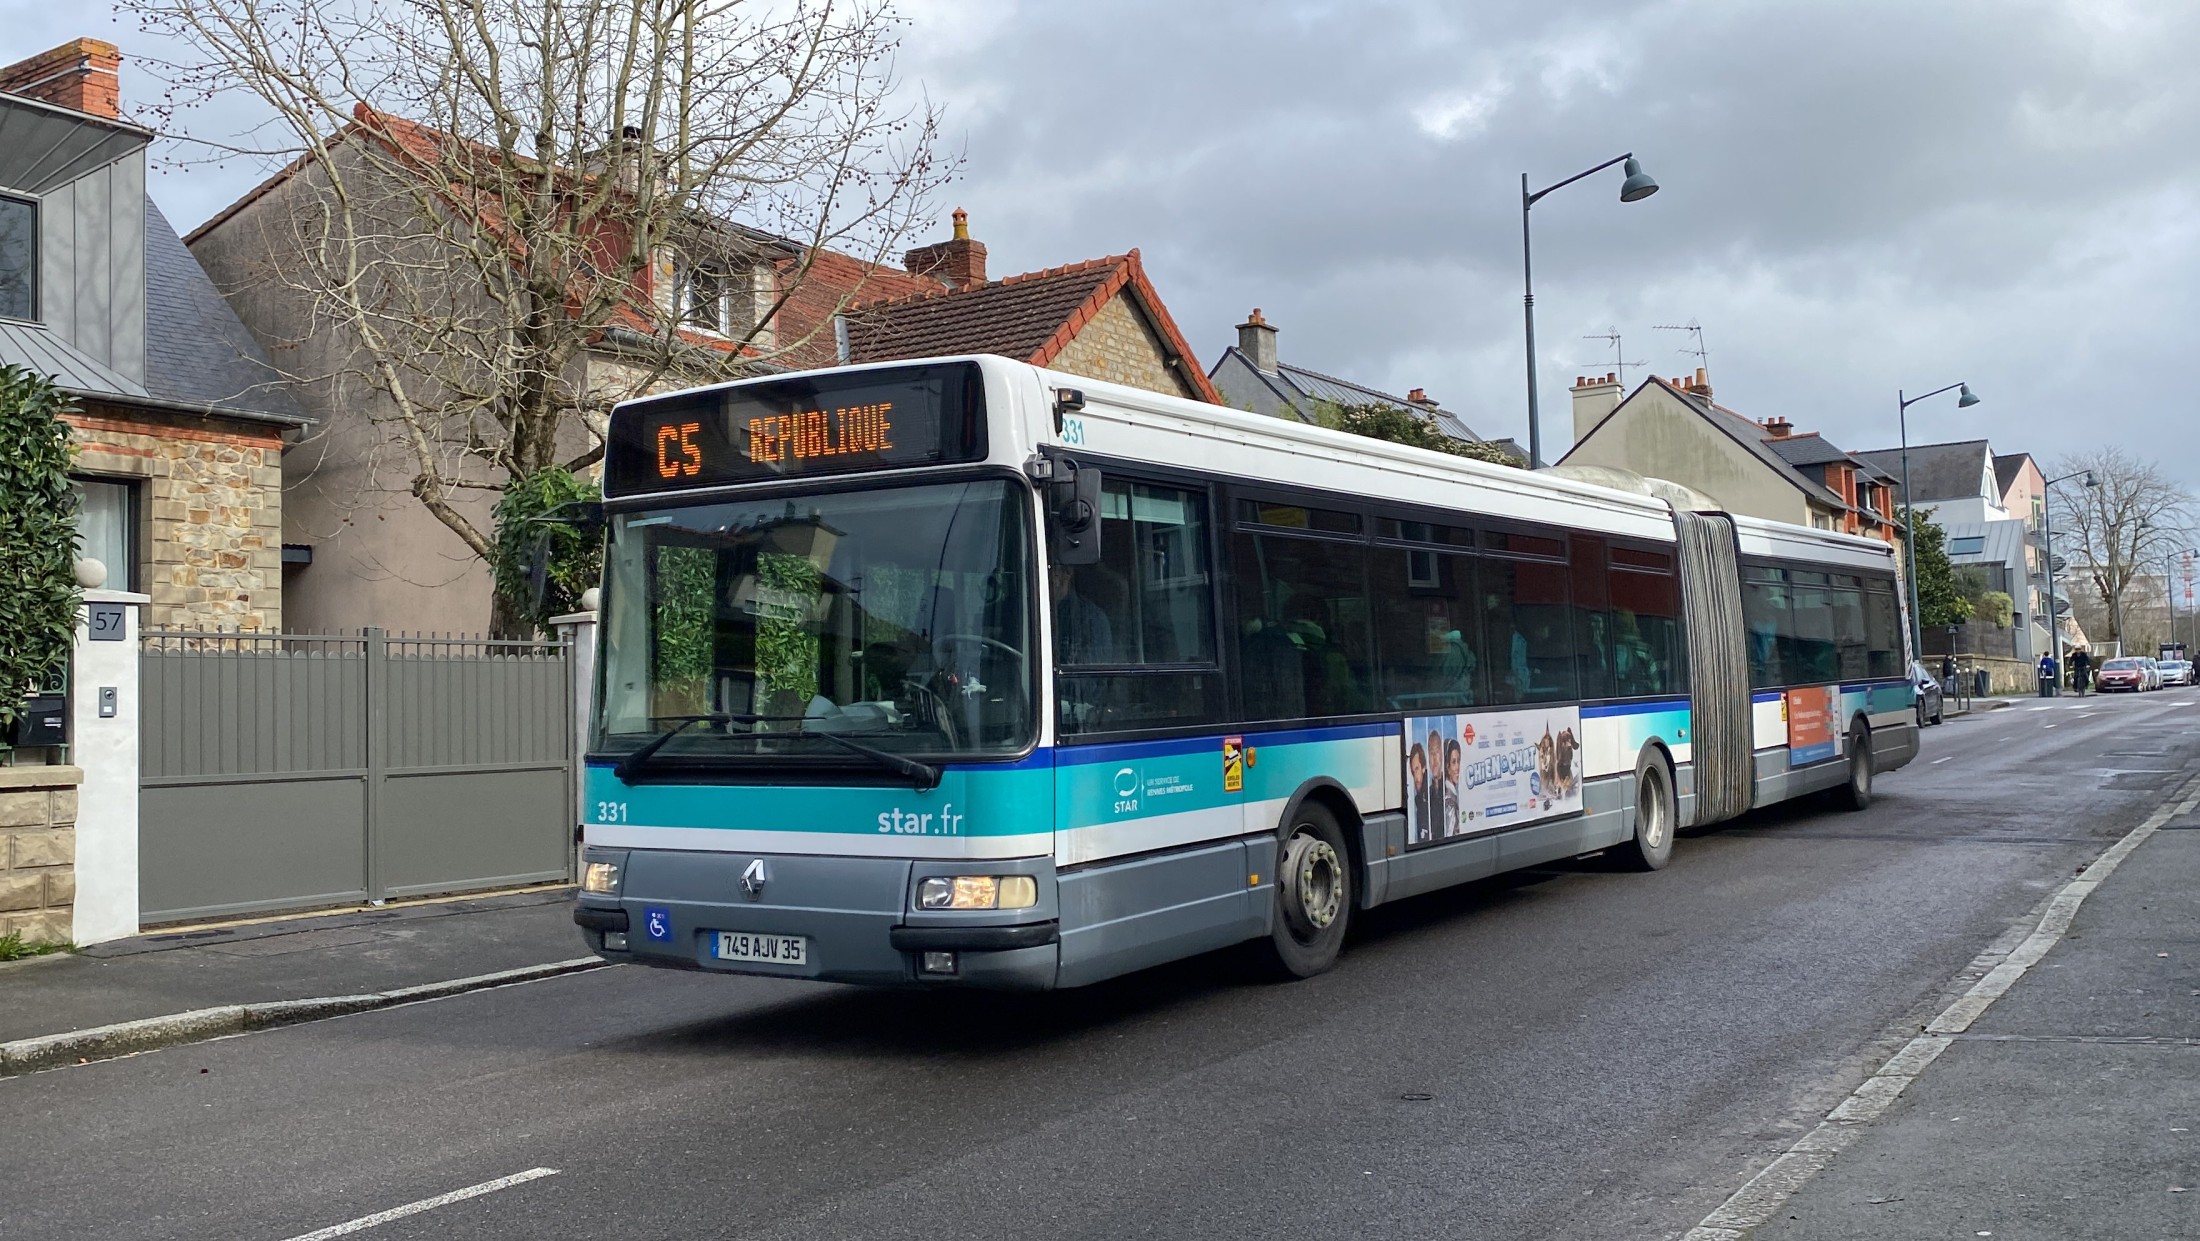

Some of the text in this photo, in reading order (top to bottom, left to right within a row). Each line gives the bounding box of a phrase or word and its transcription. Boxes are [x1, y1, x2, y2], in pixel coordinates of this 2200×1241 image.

[657, 402, 893, 478] C5 REPUBLIQUE
[1062, 418, 1084, 445] 331
[95, 612, 122, 631] 57
[1508, 745, 1537, 775] CHAT
[1147, 784, 1194, 797] RENNES MÉTROPOLE
[1155, 776, 1172, 785] SERVICE
[597, 801, 627, 823] 331
[1114, 799, 1138, 814] STAR
[877, 803, 963, 835] star.fr
[723, 935, 800, 960] 749 AJV 35
